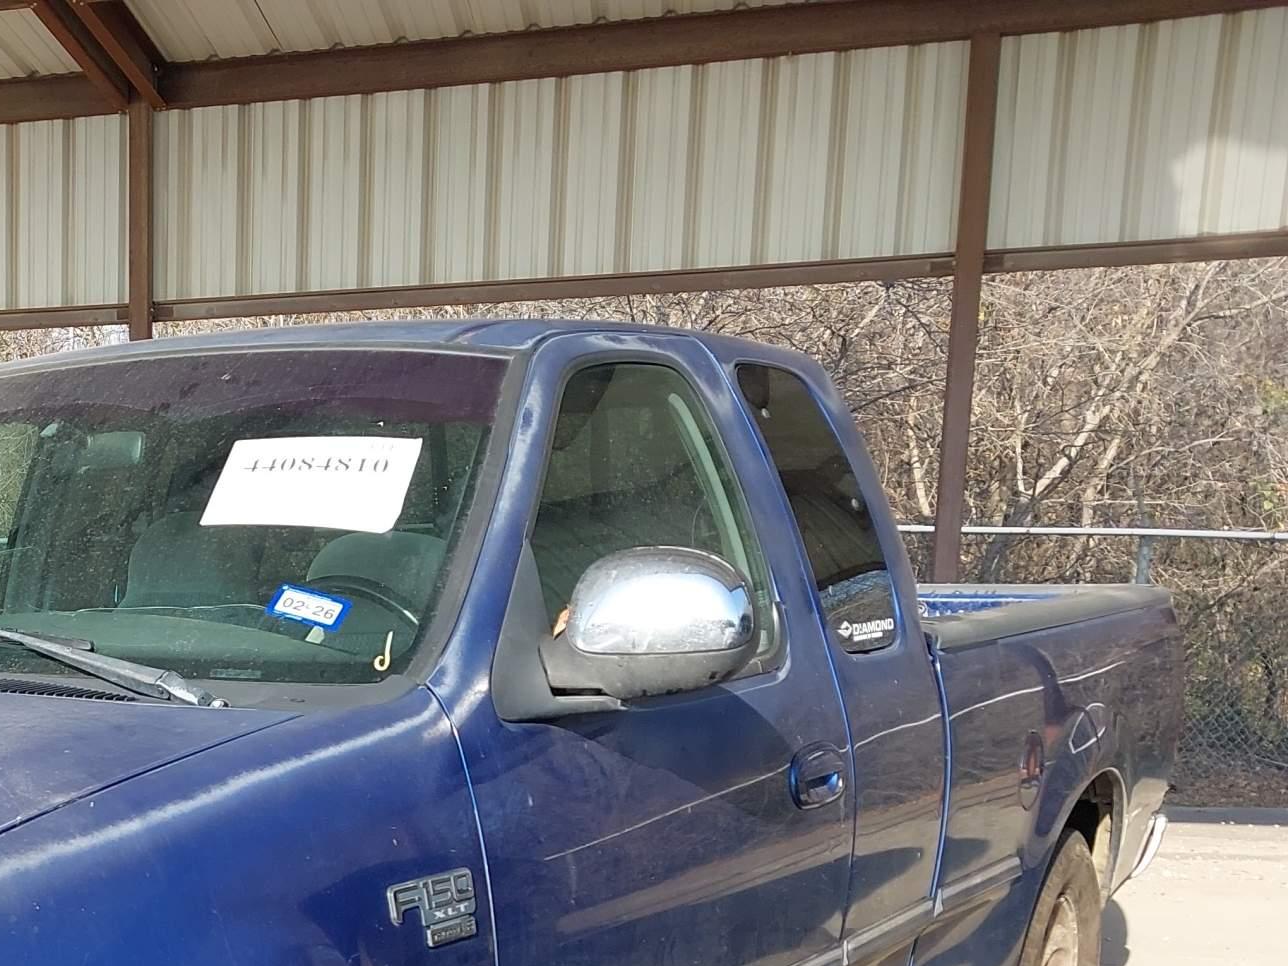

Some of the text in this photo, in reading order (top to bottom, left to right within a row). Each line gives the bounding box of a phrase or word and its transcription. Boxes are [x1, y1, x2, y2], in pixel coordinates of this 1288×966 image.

[242, 458, 388, 472] 44084810
[852, 618, 894, 635] DIAMOND
[432, 902, 469, 920] XLT
